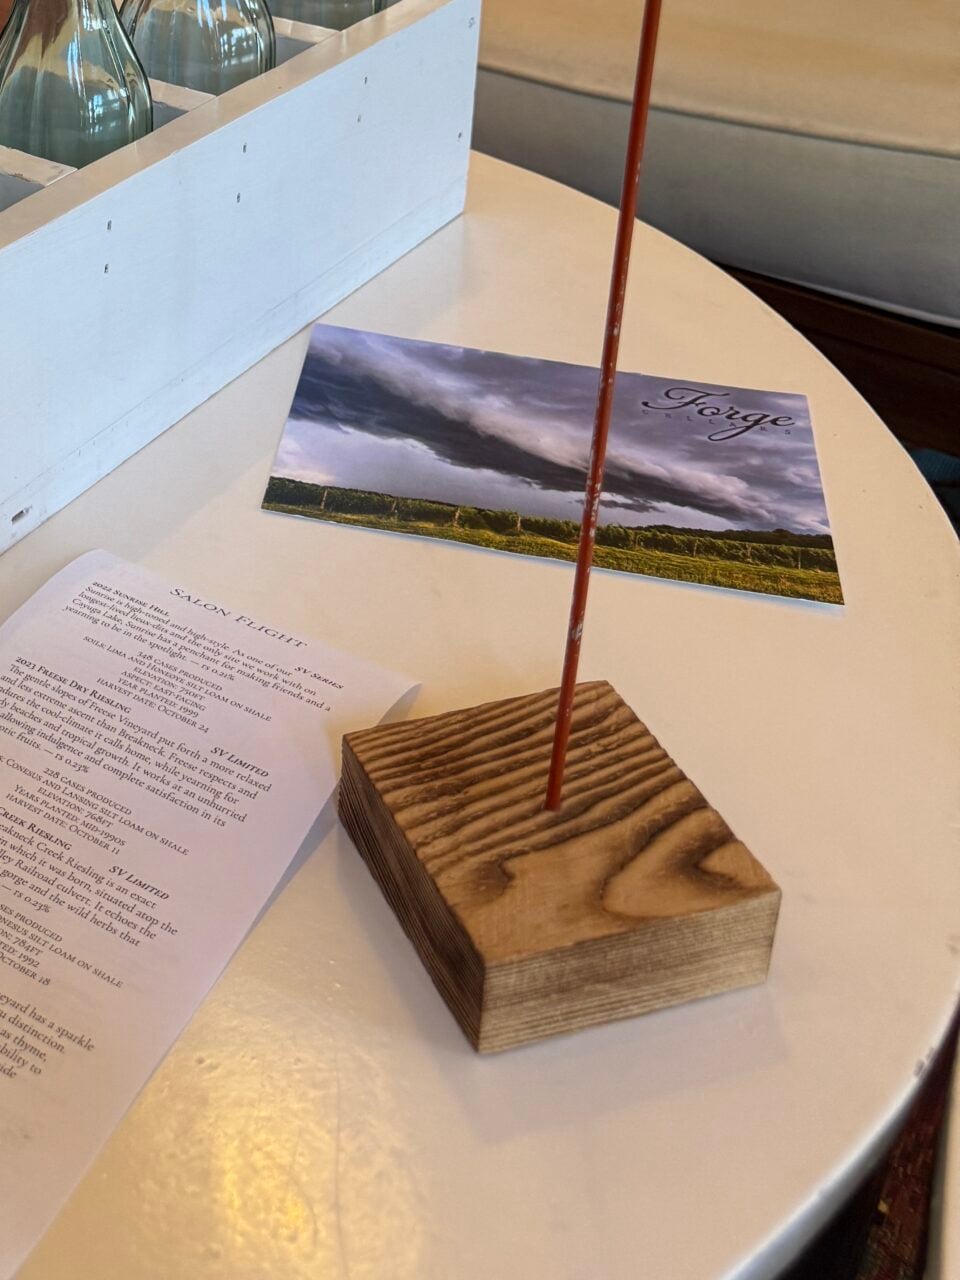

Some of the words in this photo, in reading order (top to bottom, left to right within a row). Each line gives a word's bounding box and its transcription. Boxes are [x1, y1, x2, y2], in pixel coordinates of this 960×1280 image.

[641, 387, 796, 441] Forge
[168, 587, 231, 617] SALON
[234, 614, 308, 647] FLIGHT
[14, 655, 37, 670] 2023
[36, 665, 69, 685] FREESE
[67, 679, 90, 694] DRY
[88, 689, 132, 714] RIESLING
[0, 674, 19, 686] and
[15, 679, 33, 693] less
[32, 689, 68, 710] extreme
[66, 705, 96, 723] ascent
[95, 718, 117, 734] than
[166, 751, 198, 772] Freese
[197, 767, 241, 790] respects
[236, 786, 259, 800] and
[8, 662, 25, 677] The
[21, 672, 51, 689] gentle
[49, 684, 79, 702] slopes
[76, 697, 92, 706] of
[87, 700, 117, 720] Freese
[118, 713, 160, 740] Vineyard
[155, 735, 176, 748] put
[175, 741, 201, 760] forth
[200, 756, 209, 764] a
[208, 759, 235, 776] more
[234, 771, 272, 792] relaxed
[35, 727, 84, 757] indulgence
[82, 753, 104, 767] and
[101, 762, 145, 788] complete
[144, 783, 200, 815] satisfaction
[199, 808, 212, 820] in
[212, 814, 227, 827] its
[209, 746, 229, 757] SV
[226, 753, 269, 777] LIMITED
[4, 792, 44, 815] HARVEST
[67, 823, 111, 851] OCTOBER
[25, 822, 72, 851] RIESLING
[8, 842, 42, 862] which
[34, 854, 49, 867] it
[48, 863, 67, 878] was
[93, 887, 137, 913] situated
[134, 909, 160, 927] atop
[159, 921, 178, 936] the
[13, 858, 59, 887] Railroad
[92, 900, 105, 912] It
[103, 908, 139, 931] echoes
[135, 925, 157, 940] the
[31, 840, 64, 862] Creek
[63, 855, 106, 885] Riesling
[104, 876, 117, 889] is
[114, 884, 129, 895] an
[127, 891, 157, 909] exact
[107, 865, 127, 876] SV
[124, 874, 170, 900] LIMITED
[37, 975, 51, 986] 18
[26, 1006, 48, 1025] has
[45, 1020, 55, 1030] a
[53, 1025, 95, 1052] sparkle
